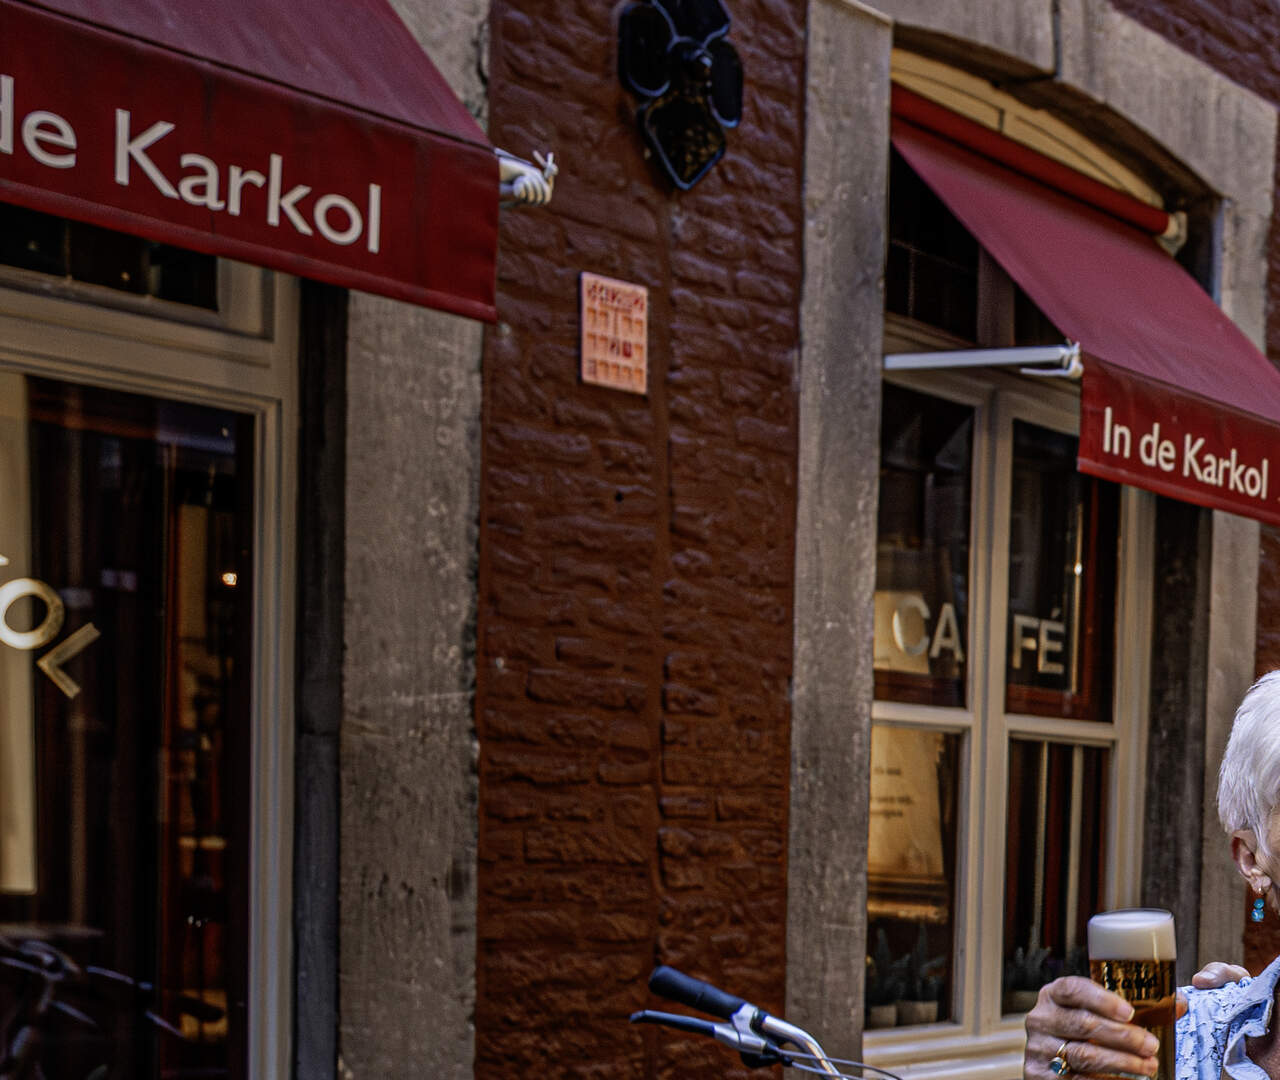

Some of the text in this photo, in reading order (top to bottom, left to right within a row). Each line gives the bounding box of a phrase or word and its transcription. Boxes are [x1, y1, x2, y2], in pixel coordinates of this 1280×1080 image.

[0, 74, 381, 254] e Karkol
[1103, 406, 1269, 499] In de Karkol
